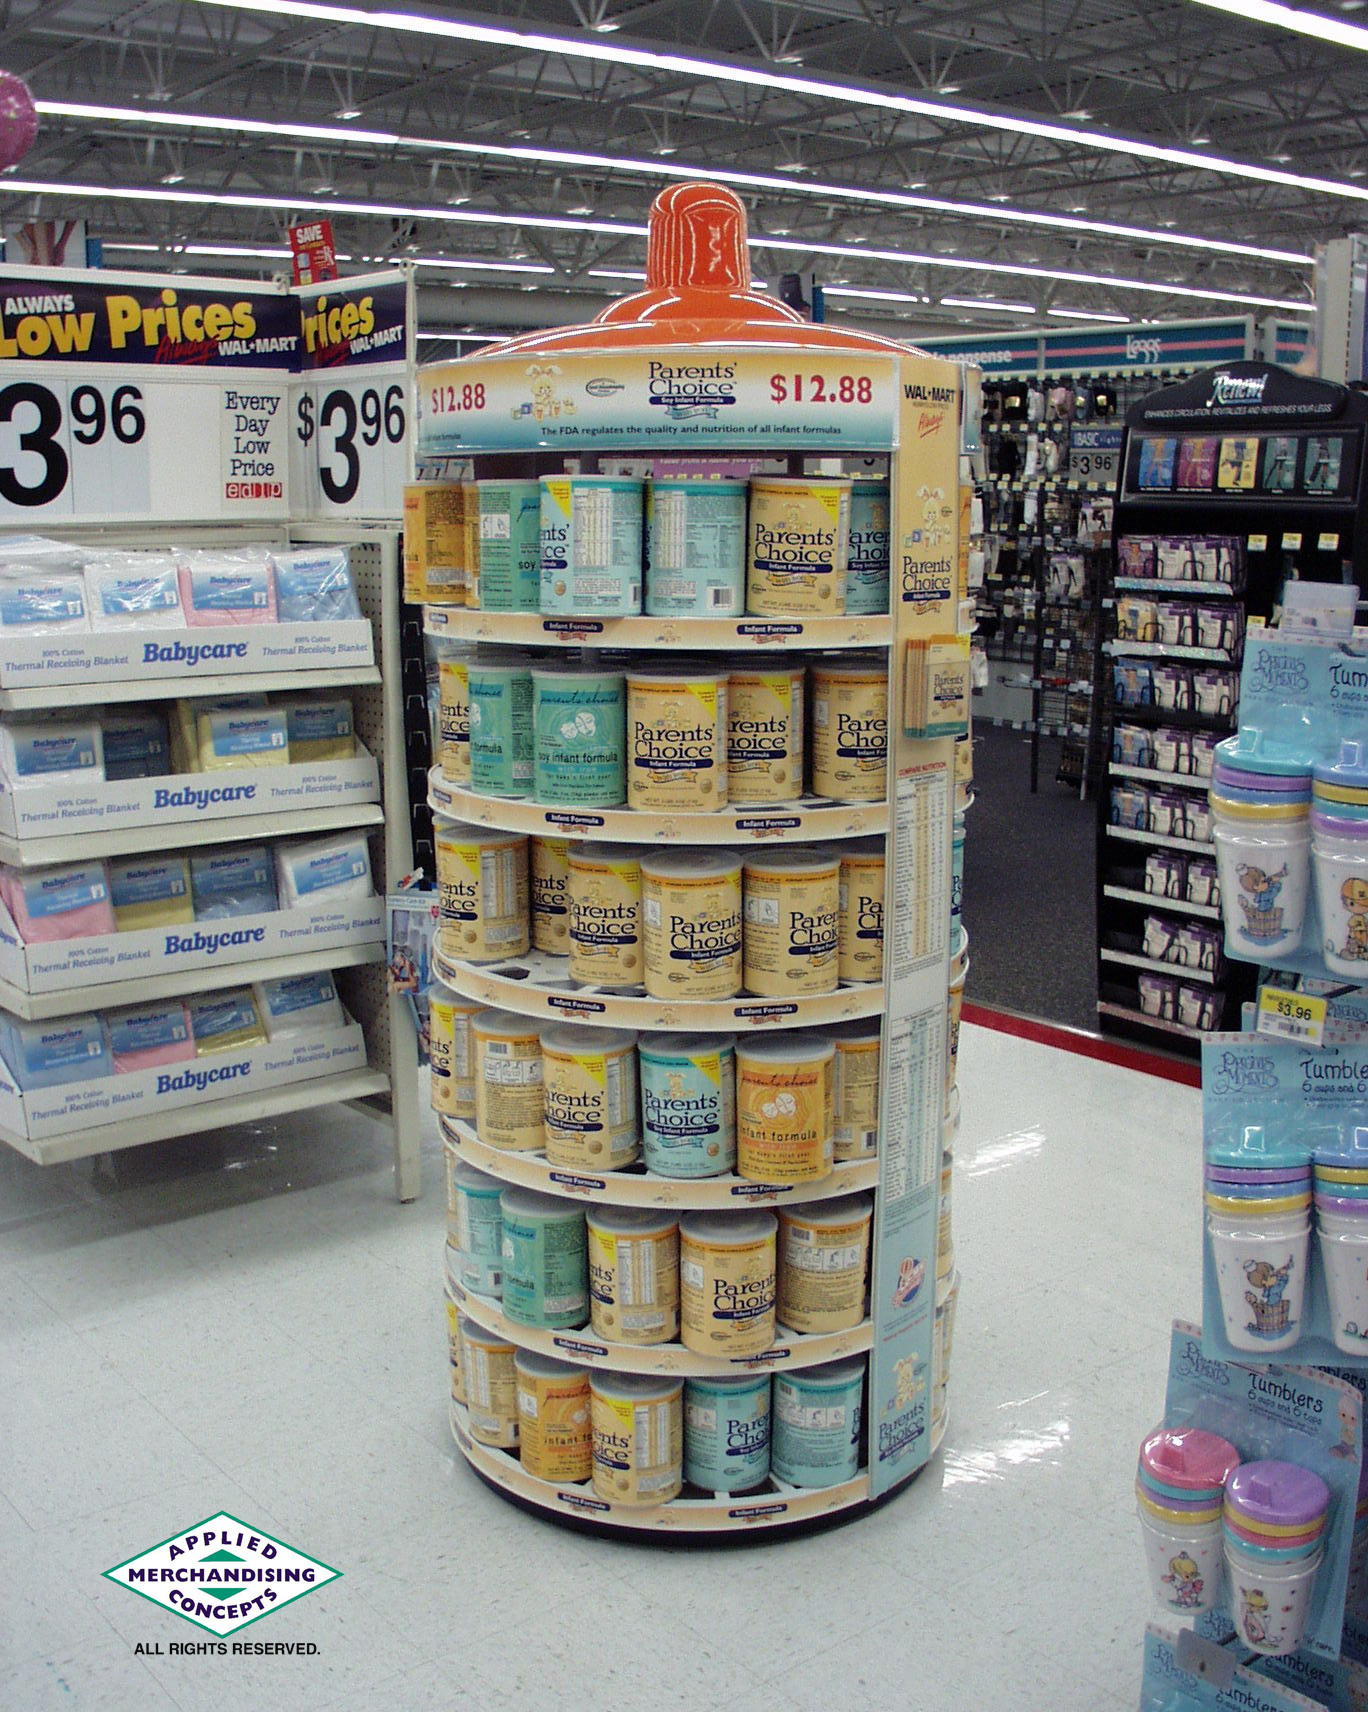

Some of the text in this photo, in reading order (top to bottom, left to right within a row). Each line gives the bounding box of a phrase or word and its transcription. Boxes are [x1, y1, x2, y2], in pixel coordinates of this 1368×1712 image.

[296, 225, 323, 244] SAVE
[5, 294, 75, 315] ALWAYS
[105, 289, 256, 351] Prices
[301, 297, 374, 352] rices
[649, 361, 737, 379] Parents'
[649, 379, 734, 395] Choice
[770, 373, 873, 404] $12.88
[225, 391, 281, 415] Every
[432, 383, 485, 414] $12.88
[235, 416, 269, 437] Day
[542, 425, 842, 437] The FDA regulates the quality and nutrition of all infant formulas
[234, 437, 270, 455] Low
[230, 458, 275, 477] Price
[755, 523, 836, 545] Parents'
[754, 543, 833, 563] Choice
[519, 562, 536, 573] soy
[903, 556, 952, 574] Parents'
[902, 574, 950, 592] Choice
[549, 622, 598, 633] Infant Formula
[744, 625, 798, 633] Infant Formula
[143, 640, 249, 666] Babycare
[5, 661, 45, 672] Thermal
[93, 656, 129, 667] Blanket
[1330, 686, 1340, 698] 6
[634, 721, 716, 742] Parents'
[728, 715, 789, 733] rents'
[552, 752, 579, 764] infant
[583, 752, 618, 763] formula
[634, 740, 713, 758] Choice
[154, 784, 257, 810] Babycare
[21, 812, 59, 822] Thermal
[106, 803, 141, 813] Blanket
[551, 814, 600, 825] Infant Formula
[743, 818, 796, 828] Infant Formula
[571, 916, 636, 935] hoice
[164, 926, 266, 957] Babycare
[33, 962, 70, 974] Thermal
[117, 951, 151, 962] Blanket
[741, 1005, 793, 1015] Infant Formula
[1277, 1002, 1312, 1021] $3.96
[156, 1060, 251, 1095] Babycare
[1302, 1081, 1311, 1092] 6
[1337, 1082, 1354, 1092] and
[1357, 1080, 1366, 1092] 6
[32, 1107, 68, 1120] Thermal
[112, 1091, 144, 1103] Blanket
[548, 1089, 604, 1107] rents'
[645, 1088, 720, 1111] Parents'
[645, 1106, 718, 1127] Choice
[771, 1129, 817, 1141] formula
[738, 1185, 758, 1193] Infant
[1248, 1373, 1323, 1412] Tumblers
[1268, 1653, 1334, 1687] umblers
